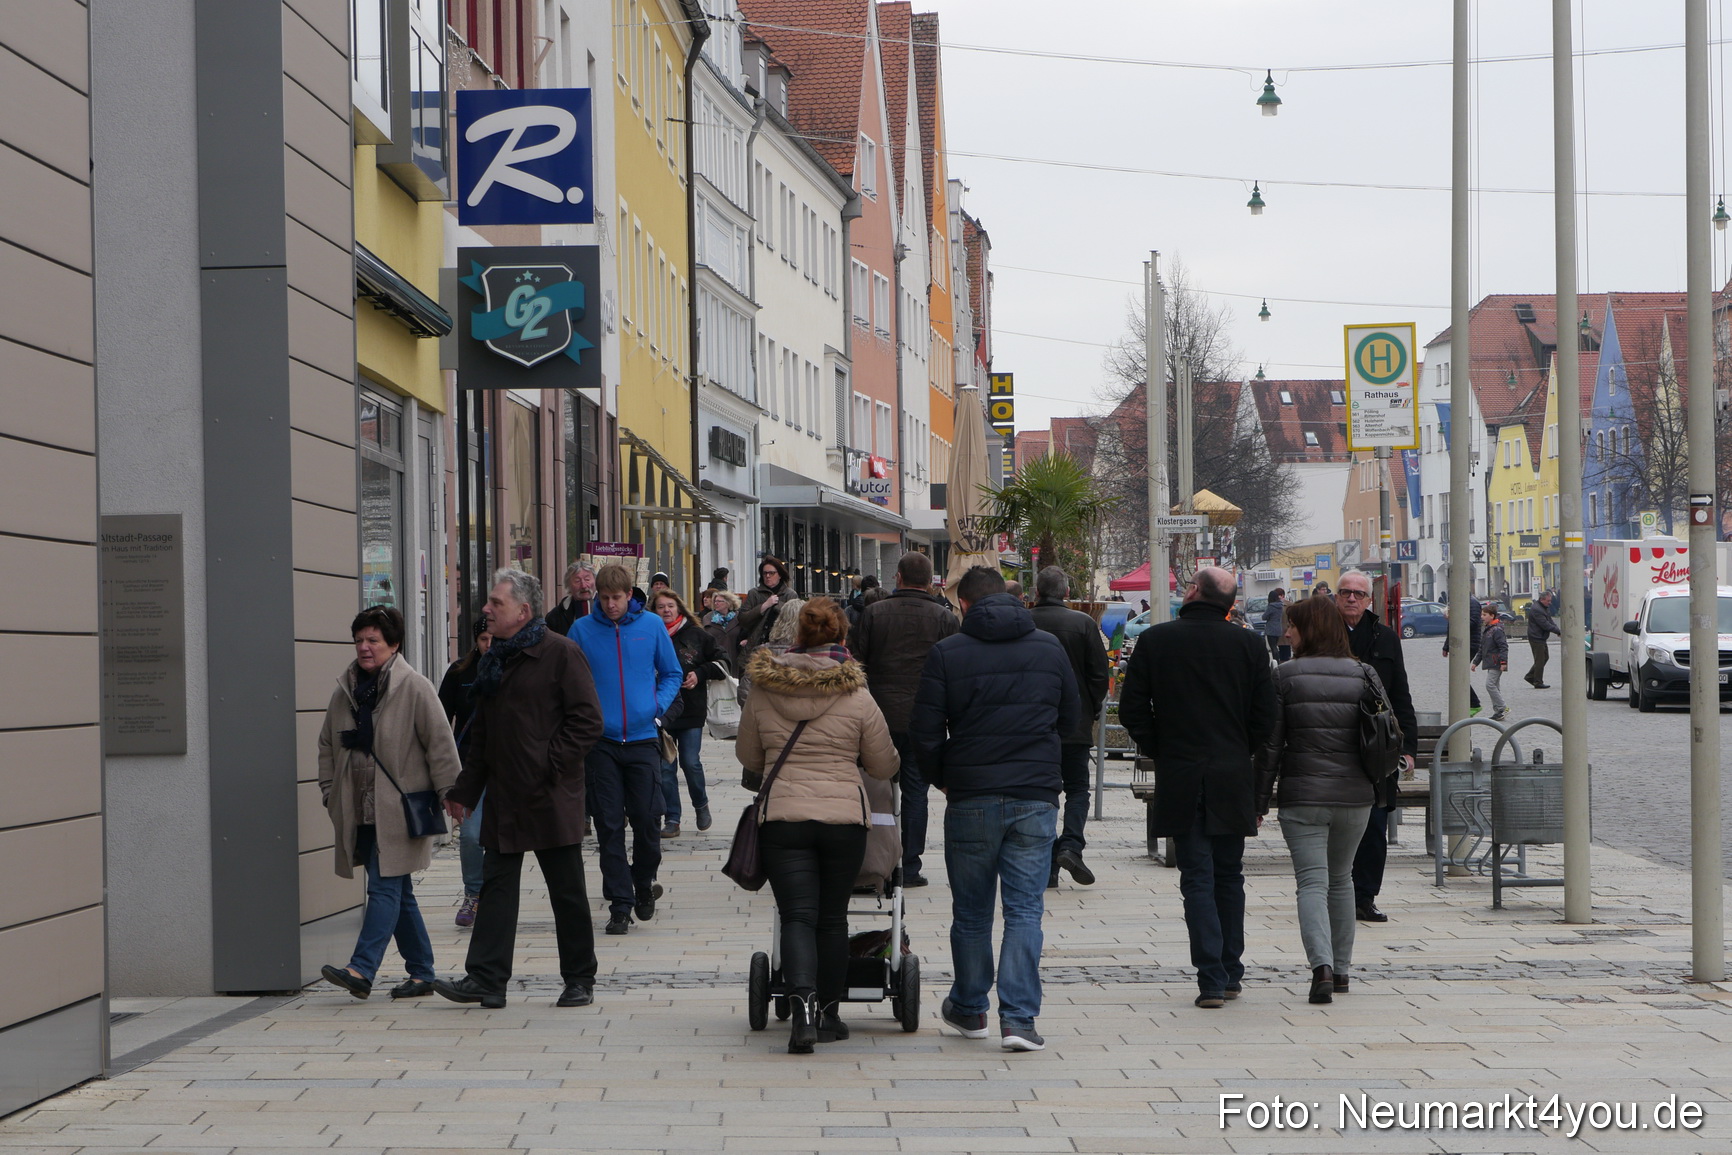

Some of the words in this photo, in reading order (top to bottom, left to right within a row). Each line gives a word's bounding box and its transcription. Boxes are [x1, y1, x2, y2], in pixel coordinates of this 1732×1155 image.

[465, 105, 584, 207] R.
[504, 284, 552, 342] G2
[1369, 343, 1392, 373] H
[1364, 391, 1399, 399] Rathaus
[991, 375, 1014, 474] HOTE
[860, 481, 891, 494] utor.
[1157, 517, 1197, 526] Klostergasse
[1645, 515, 1652, 523] H
[101, 533, 173, 543] Altstadt-Passage
[130, 544, 142, 552] mit
[143, 544, 173, 552] Tradition
[1650, 561, 1690, 584] Lehme
